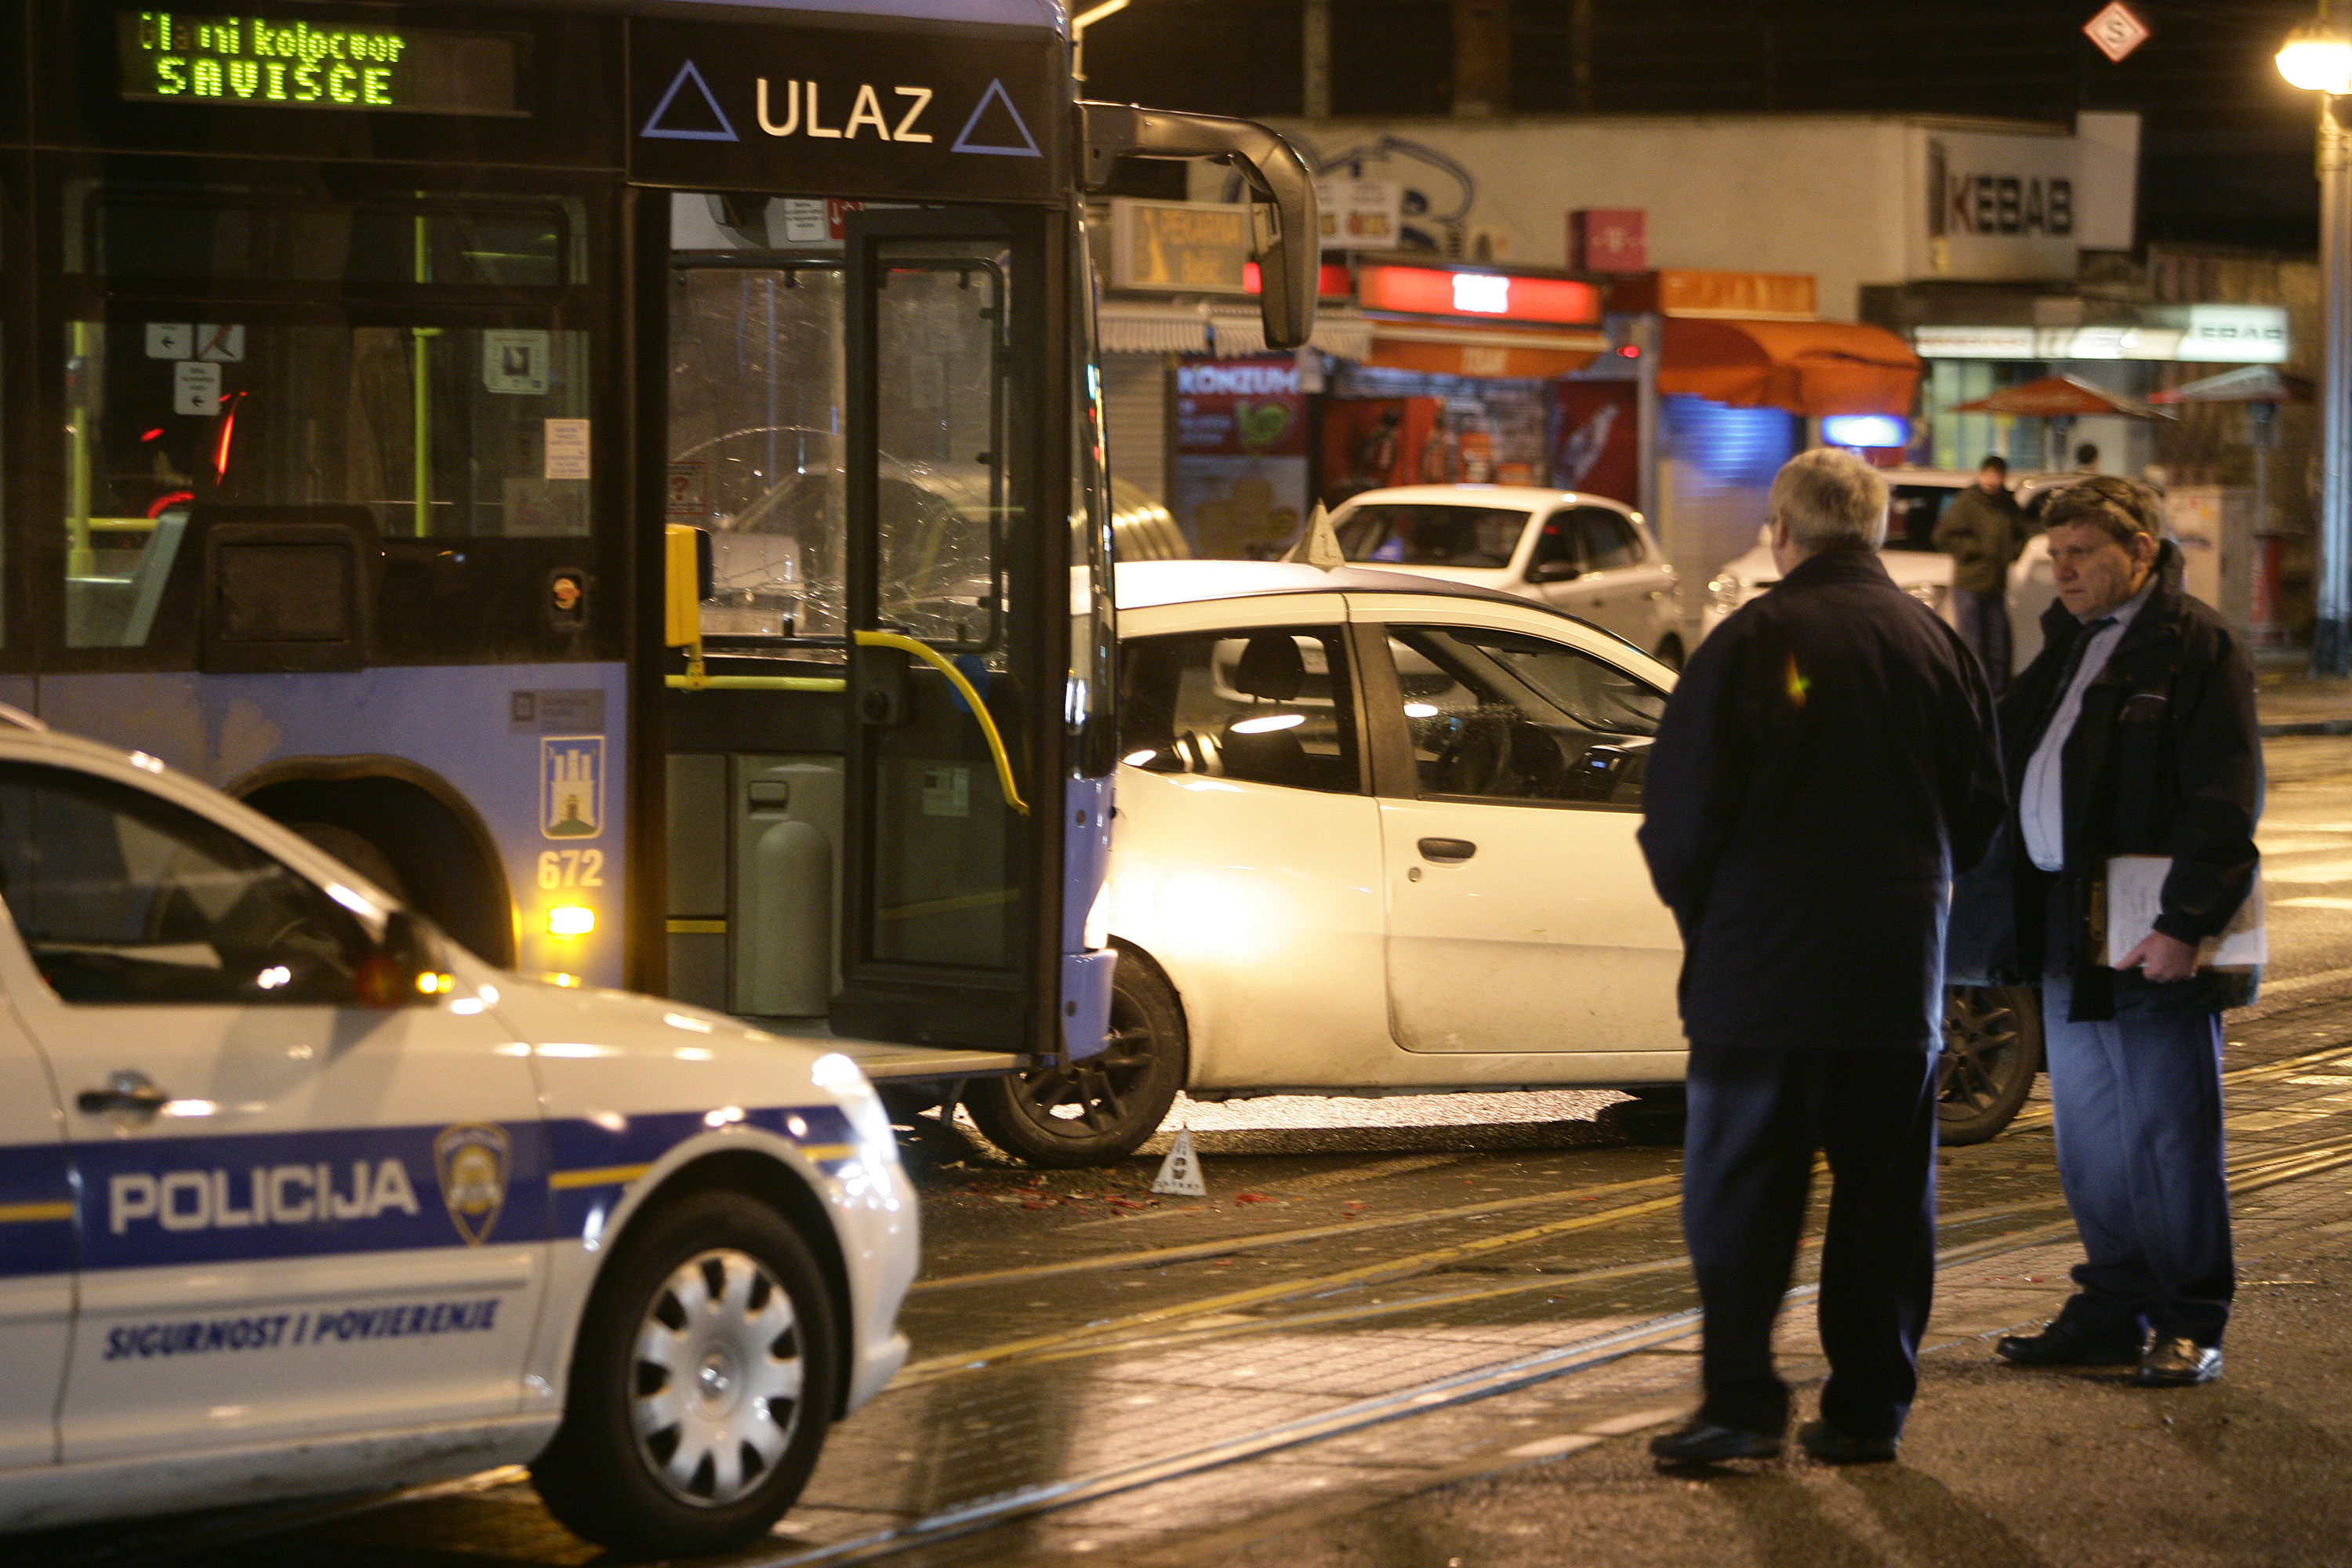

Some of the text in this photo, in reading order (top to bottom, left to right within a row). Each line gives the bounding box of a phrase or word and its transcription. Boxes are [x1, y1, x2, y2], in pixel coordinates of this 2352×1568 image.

[2106, 19, 2125, 44] S
[756, 77, 933, 143] ULAZ
[1949, 172, 2074, 235] KEBAB
[1178, 365, 1300, 395] KONZUM
[538, 848, 604, 890] 672
[108, 1158, 420, 1235] POLICIJA
[103, 1298, 499, 1361] SIGURNOST I POVJERENJE
